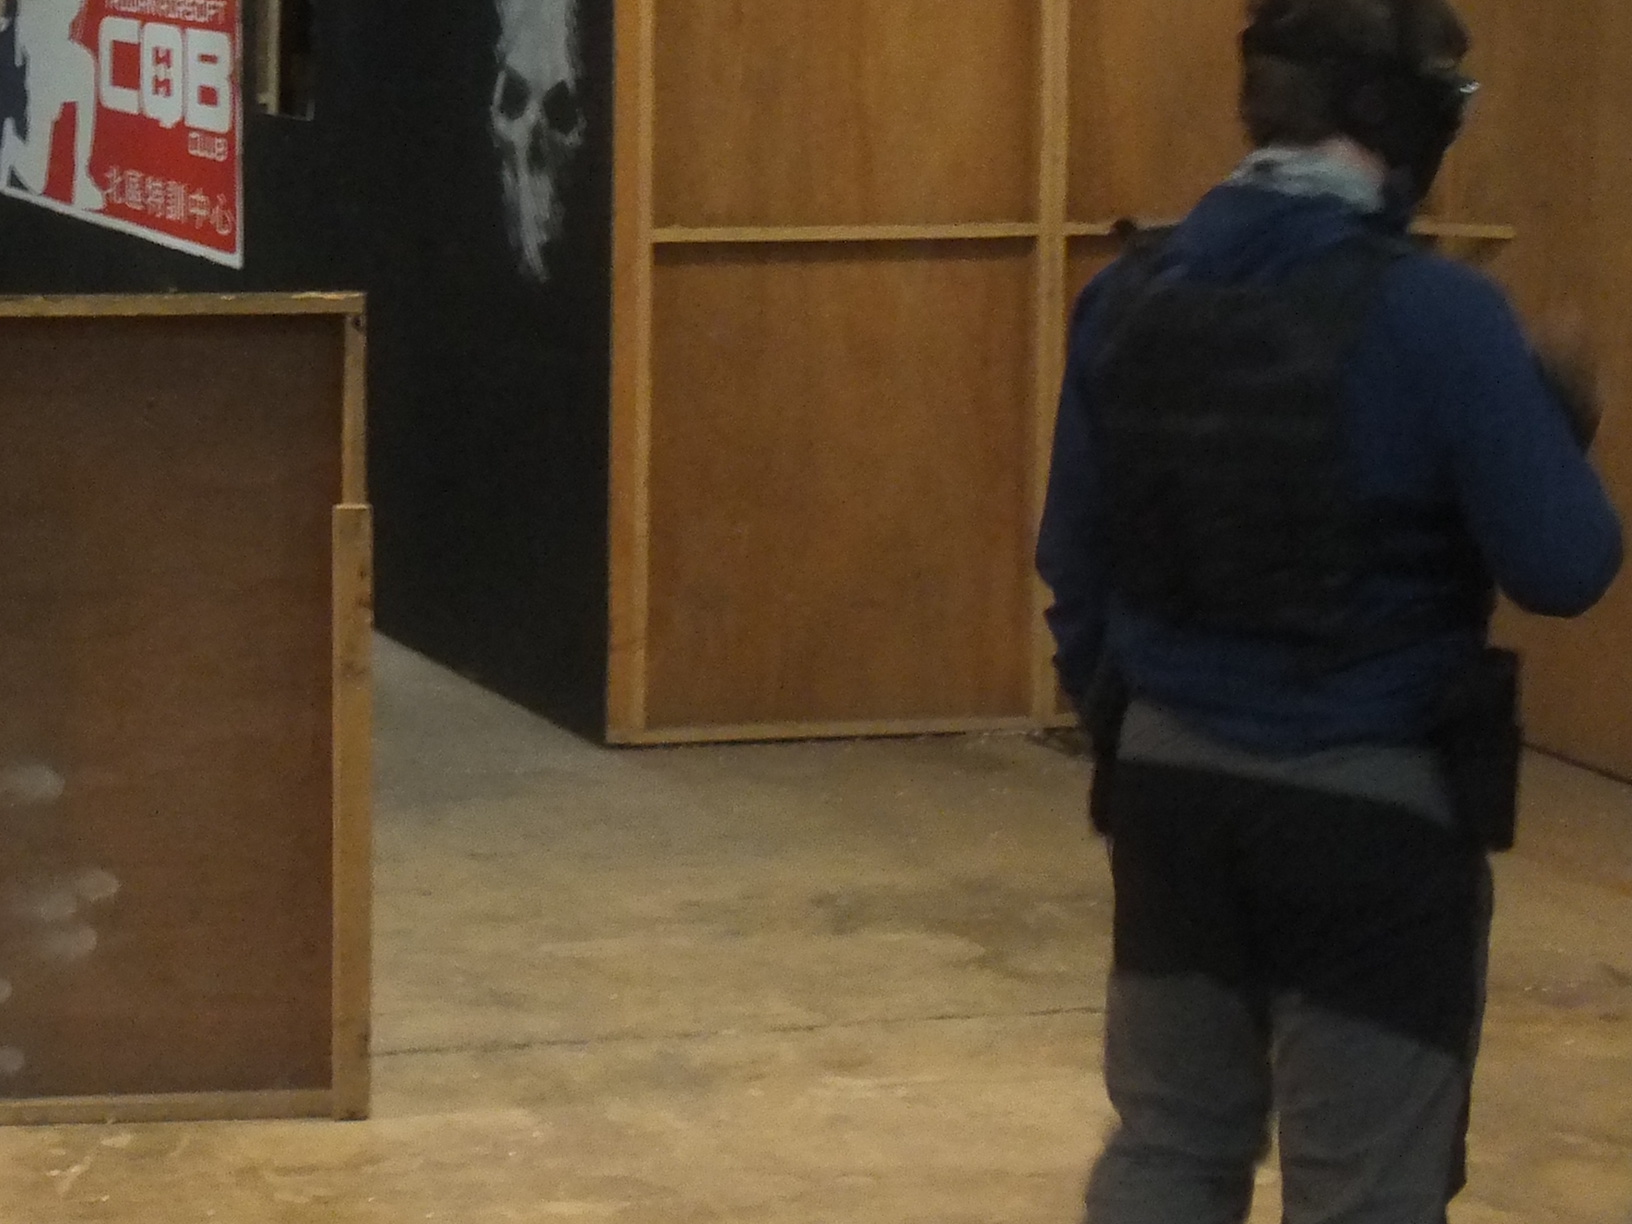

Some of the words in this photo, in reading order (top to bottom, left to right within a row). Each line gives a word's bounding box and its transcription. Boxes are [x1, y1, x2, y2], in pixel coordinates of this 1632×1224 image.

[99, 16, 231, 132] CQB
[188, 131, 229, 162] CLUB
[104, 166, 234, 235] 北區特訓中心
